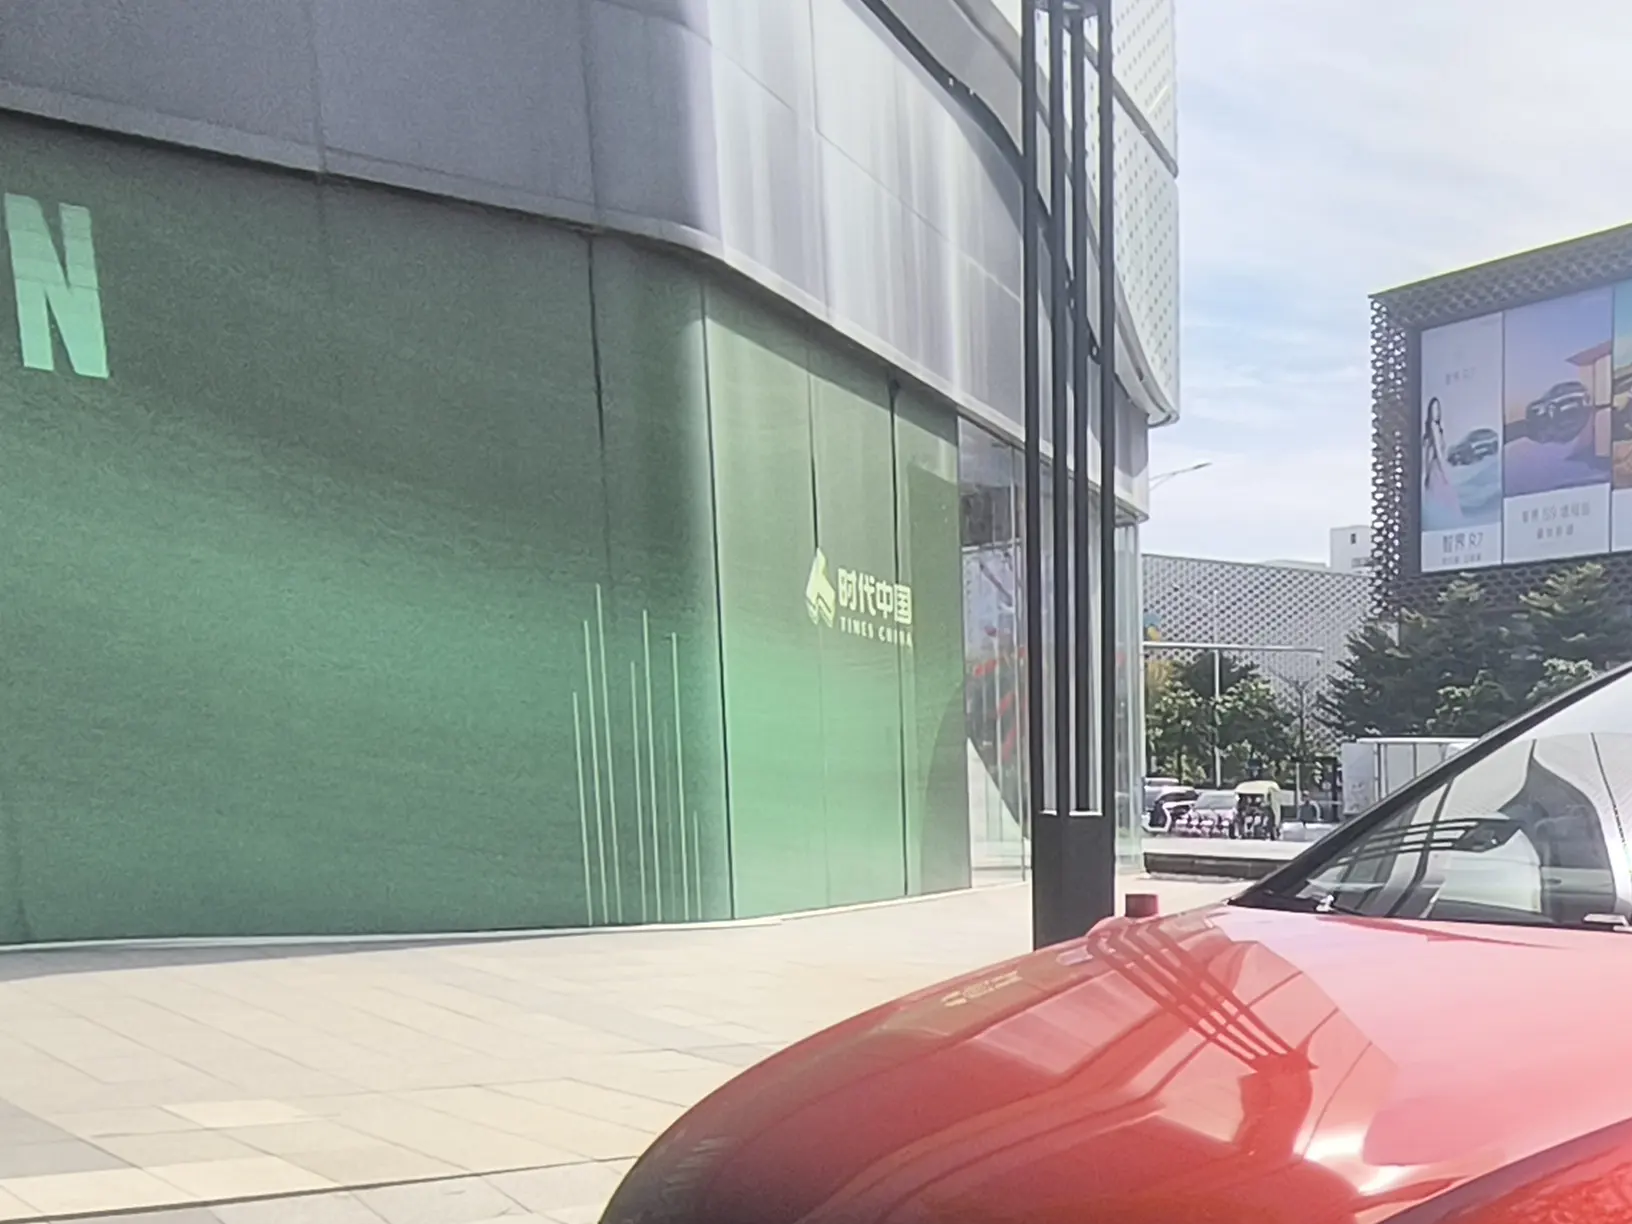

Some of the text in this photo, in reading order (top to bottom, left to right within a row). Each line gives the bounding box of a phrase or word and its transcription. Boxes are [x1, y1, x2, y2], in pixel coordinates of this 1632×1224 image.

[5, 192, 110, 379] N
[838, 567, 912, 625] 时代中国
[840, 616, 913, 648] TIMES CHINA
